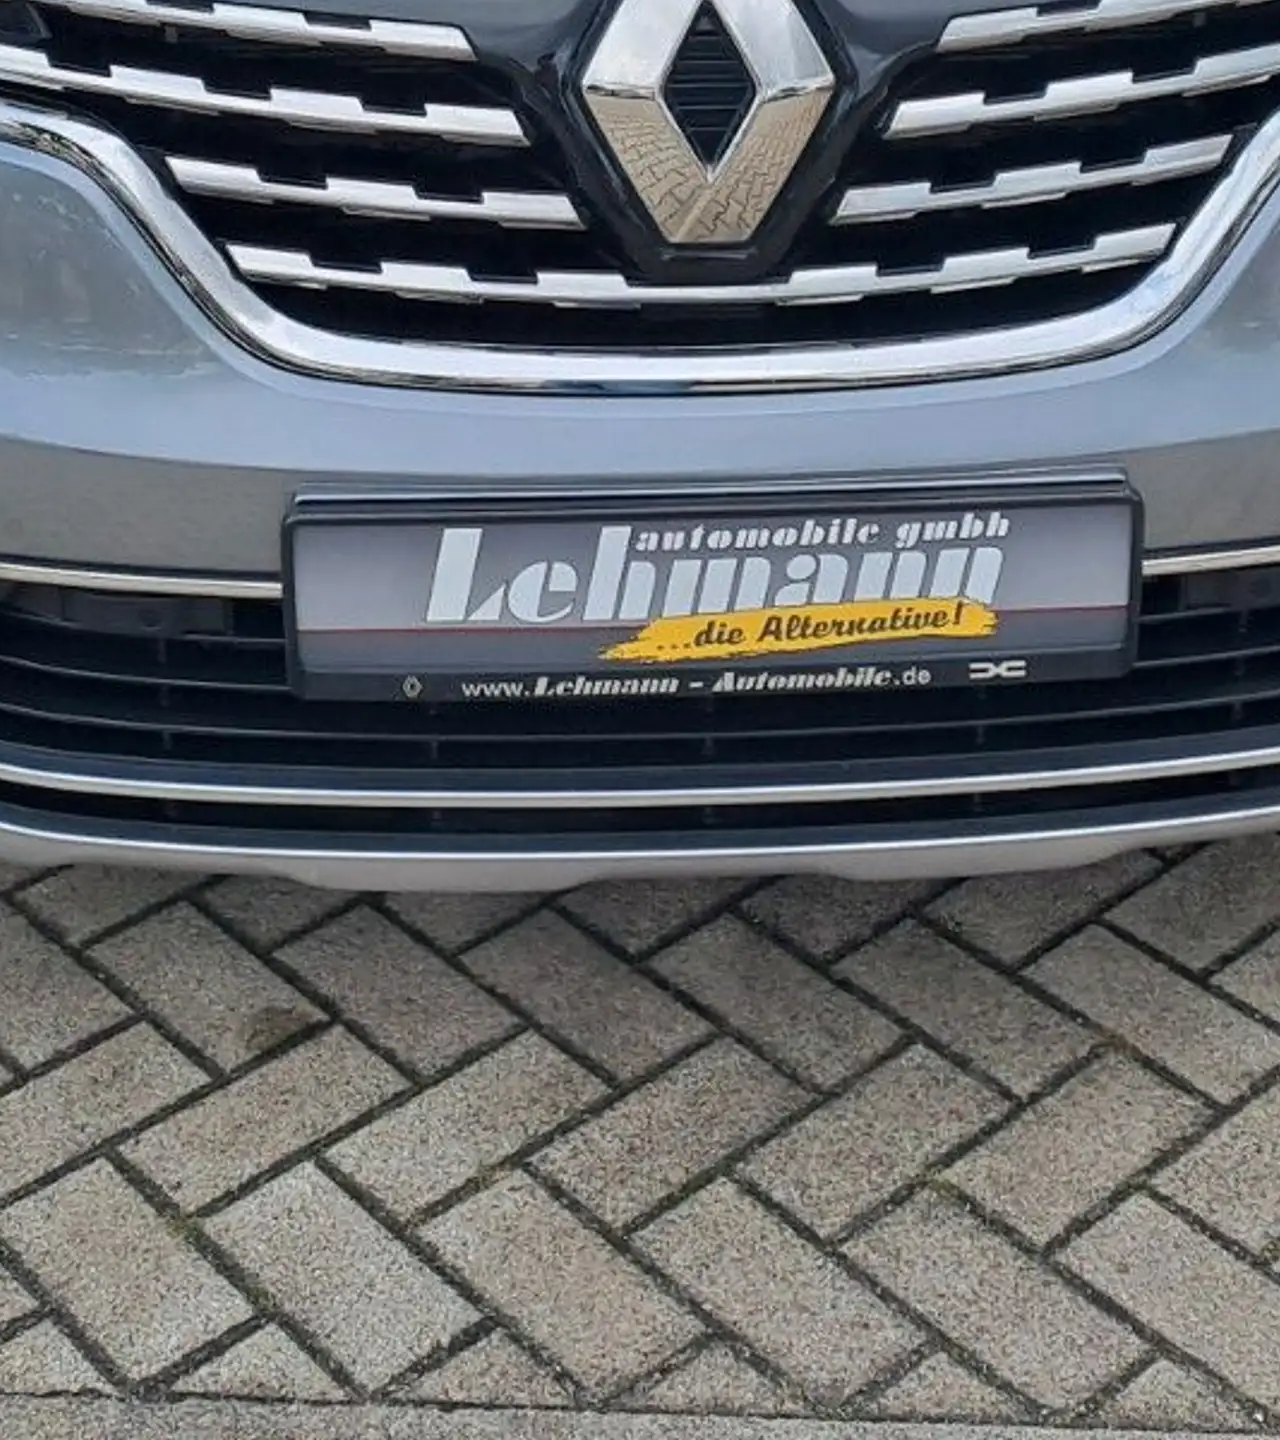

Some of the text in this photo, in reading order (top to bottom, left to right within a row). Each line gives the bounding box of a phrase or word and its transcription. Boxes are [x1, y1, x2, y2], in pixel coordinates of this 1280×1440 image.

[634, 511, 1011, 552] automobile gmbh
[425, 525, 1004, 623] Lehmann
[756, 602, 965, 643] Alternative!
